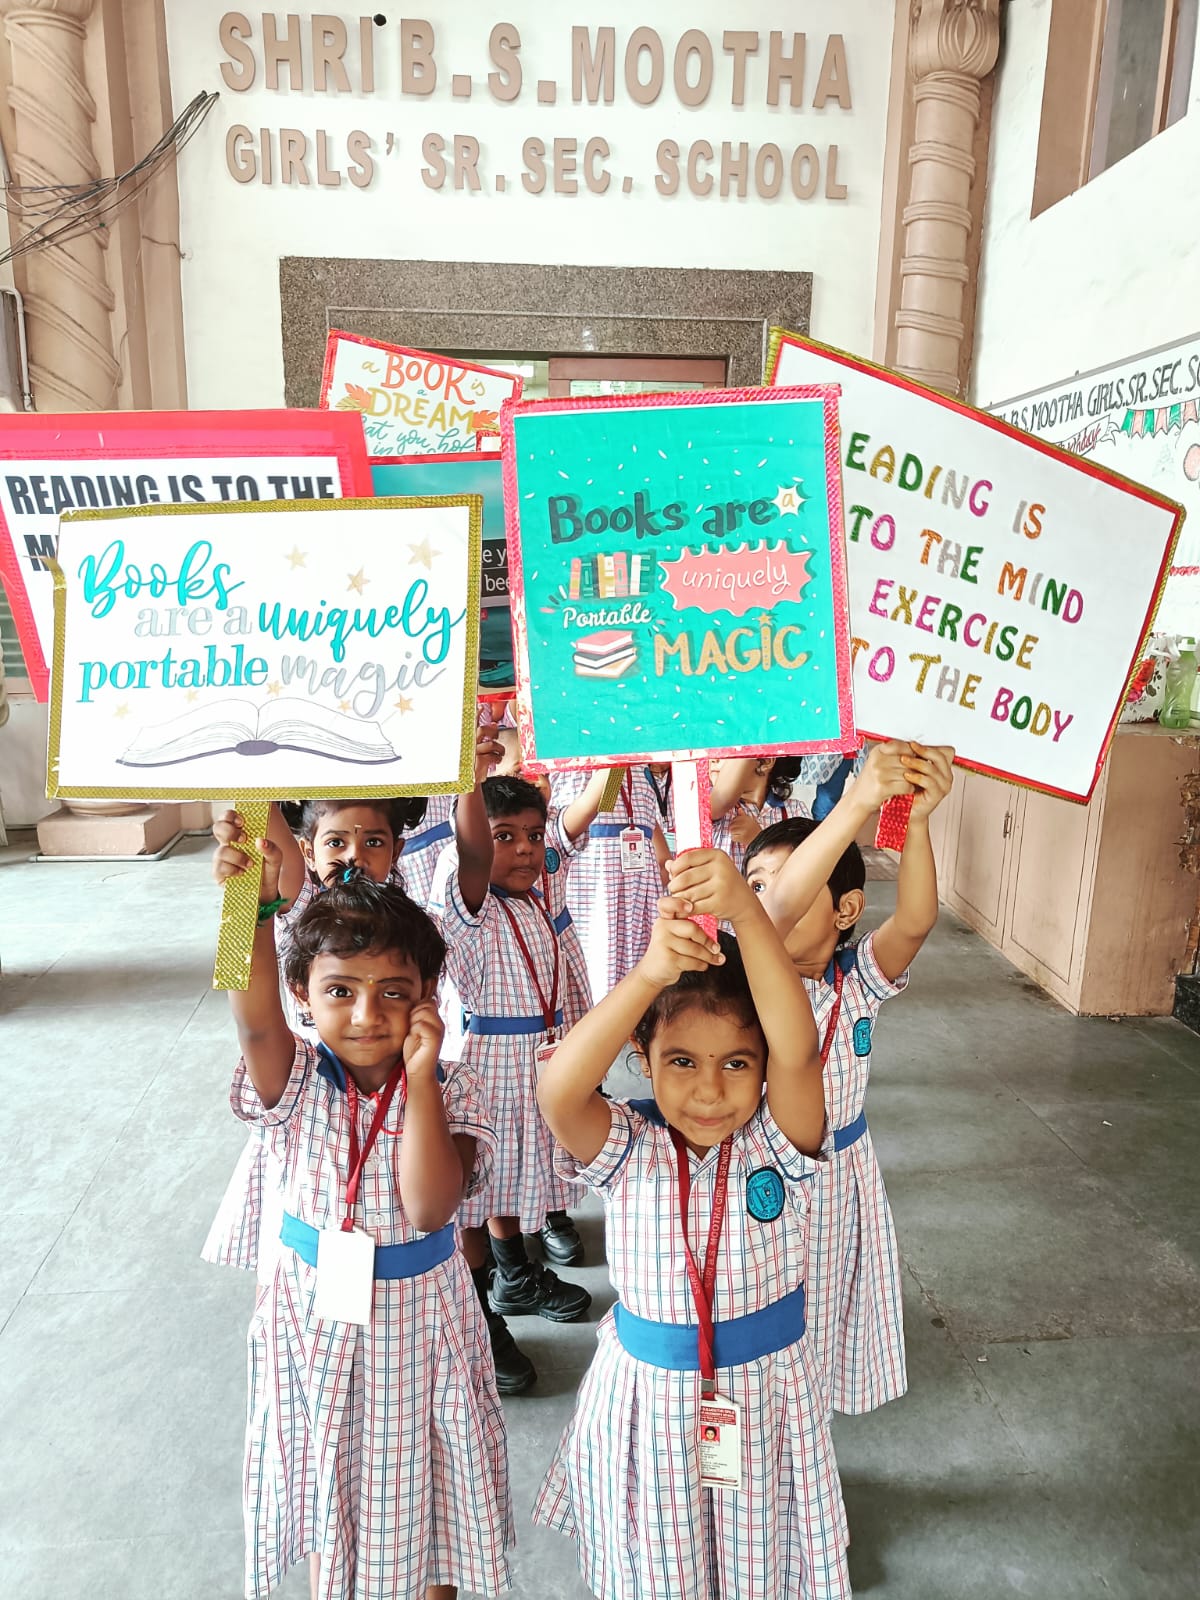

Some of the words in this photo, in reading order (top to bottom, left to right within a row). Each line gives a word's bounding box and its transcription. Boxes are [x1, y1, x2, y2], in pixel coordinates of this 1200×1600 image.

[219, 12, 375, 93] SHRI
[572, 26, 852, 110] MOOTHA
[225, 124, 394, 189] GIRLS'
[655, 139, 847, 201] SCHOOL
[367, 387, 474, 434] DREAM
[470, 378, 487, 396] is
[361, 416, 394, 440] at
[396, 429, 430, 455] you
[5, 475, 159, 515] READING
[167, 475, 206, 503] IS
[212, 475, 259, 501] TO
[268, 476, 334, 499] THE
[845, 431, 993, 517] EADING
[1012, 500, 1046, 540] IS
[549, 491, 685, 544] Books
[702, 499, 773, 537] are
[781, 493, 795, 508] a
[78, 540, 244, 618] Books
[682, 557, 791, 600] uniquely
[849, 504, 896, 551] TO
[919, 528, 984, 584] THE
[997, 561, 1084, 624] MIND
[134, 608, 212, 638] are
[223, 606, 252, 635] a
[258, 579, 466, 665] uniquely
[562, 603, 652, 629] Portable
[654, 614, 808, 676] MAGIC
[868, 579, 1039, 670] EXERCISE
[76, 645, 268, 703] portable
[281, 652, 446, 718] magic
[909, 653, 982, 710] THE
[990, 687, 1074, 743] BODY
[719, 1144, 730, 1176] SENIOR
[715, 1178, 726, 1205] GIRLS
